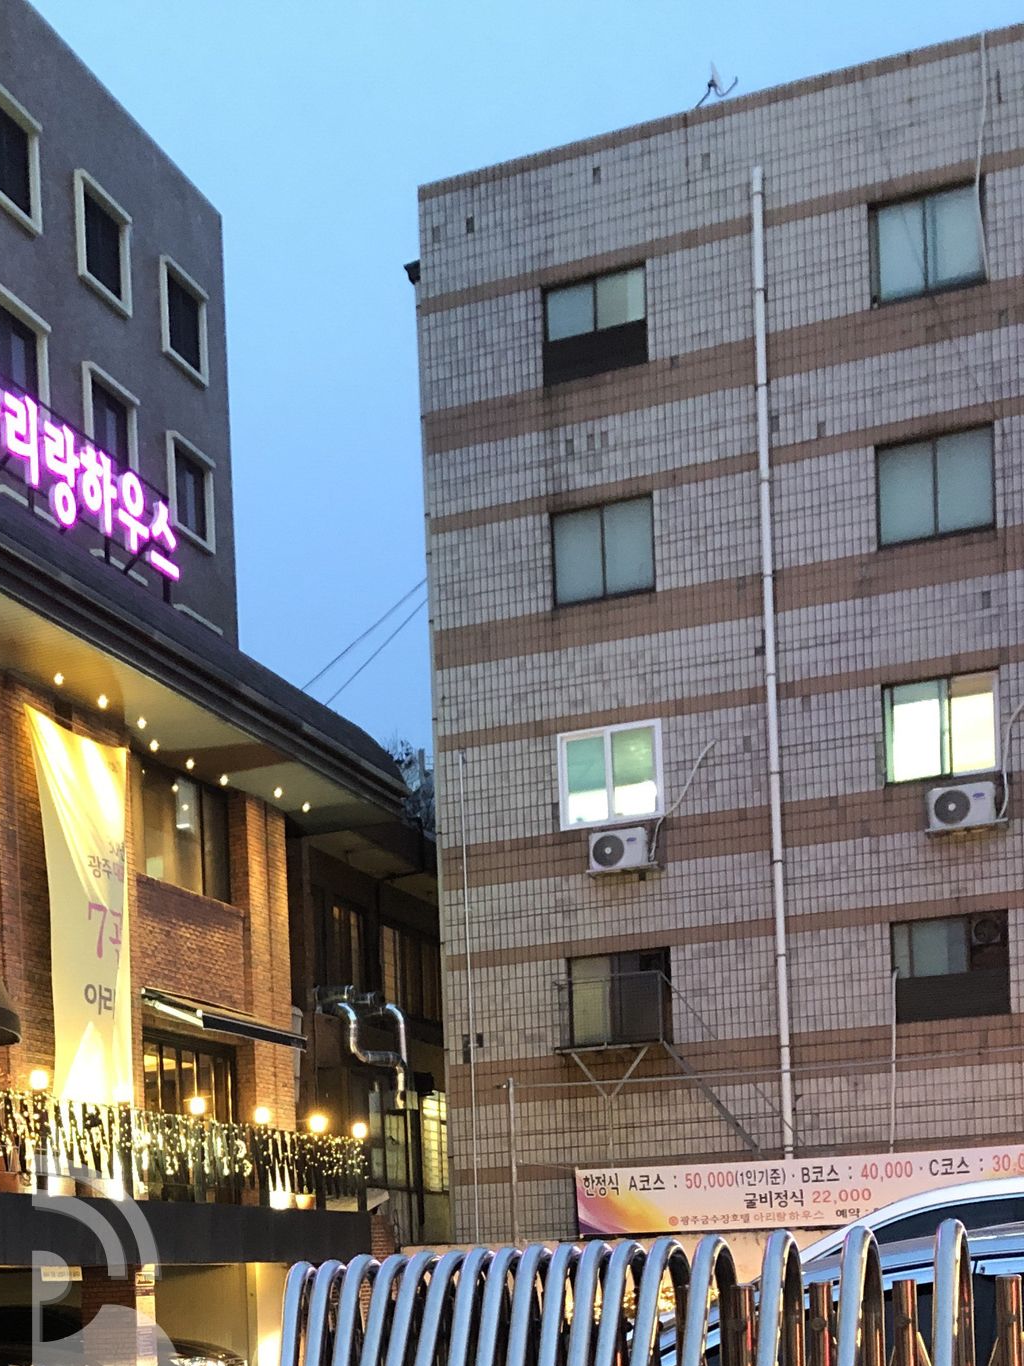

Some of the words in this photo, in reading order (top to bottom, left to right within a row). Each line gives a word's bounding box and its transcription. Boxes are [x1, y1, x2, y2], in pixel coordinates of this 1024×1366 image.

[583, 1173, 620, 1196] 한정식
[628, 1174, 666, 1192] A코스
[801, 1164, 841, 1183] B코스
[861, 1160, 913, 1182] 40,000
[929, 1156, 971, 1177] C코스
[743, 1188, 804, 1209] 굴비정식
[812, 1188, 872, 1205] 22,000
[680, 1213, 750, 1226] 광주금수장호텔
[753, 1210, 825, 1222] 아리랑하우스
